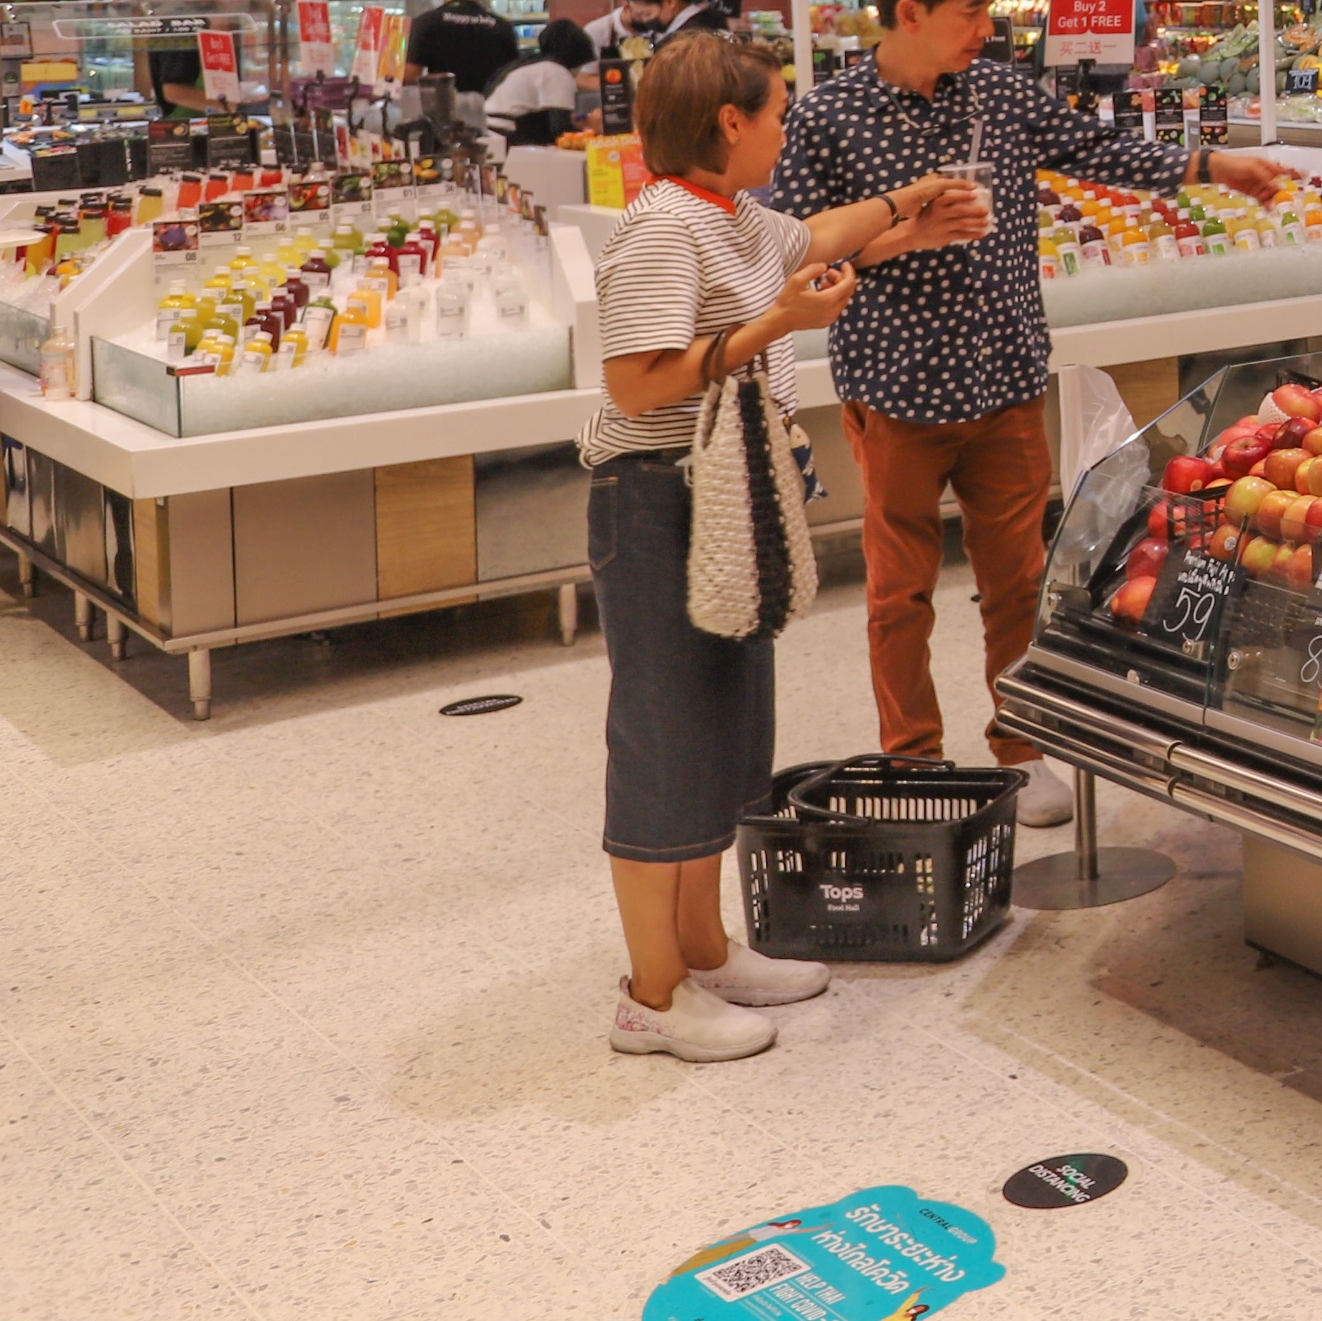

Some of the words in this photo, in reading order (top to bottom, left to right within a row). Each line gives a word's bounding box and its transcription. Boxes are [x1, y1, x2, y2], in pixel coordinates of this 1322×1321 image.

[1073, 0, 1096, 14] Buy
[1098, 0, 1107, 12] 2
[1058, 17, 1078, 28] Get
[1081, 17, 1087, 27] 1
[1091, 15, 1122, 27] FREE
[1060, 40, 1117, 56] 买二送一
[1162, 587, 1216, 642] 59
[819, 883, 865, 903] Tops
[827, 903, 844, 913] Food
[845, 903, 860, 912] Hall
[1029, 1163, 1091, 1205] DISTANCING
[1056, 1163, 1096, 1191] SOCIAL
[845, 1203, 967, 1284] รักษาระยะห่าง
[811, 1229, 912, 1295] ห่างไกลโควิด
[768, 1283, 801, 1308] FIGHT
[796, 1271, 825, 1293] HELP
[821, 1286, 847, 1306] THAI
